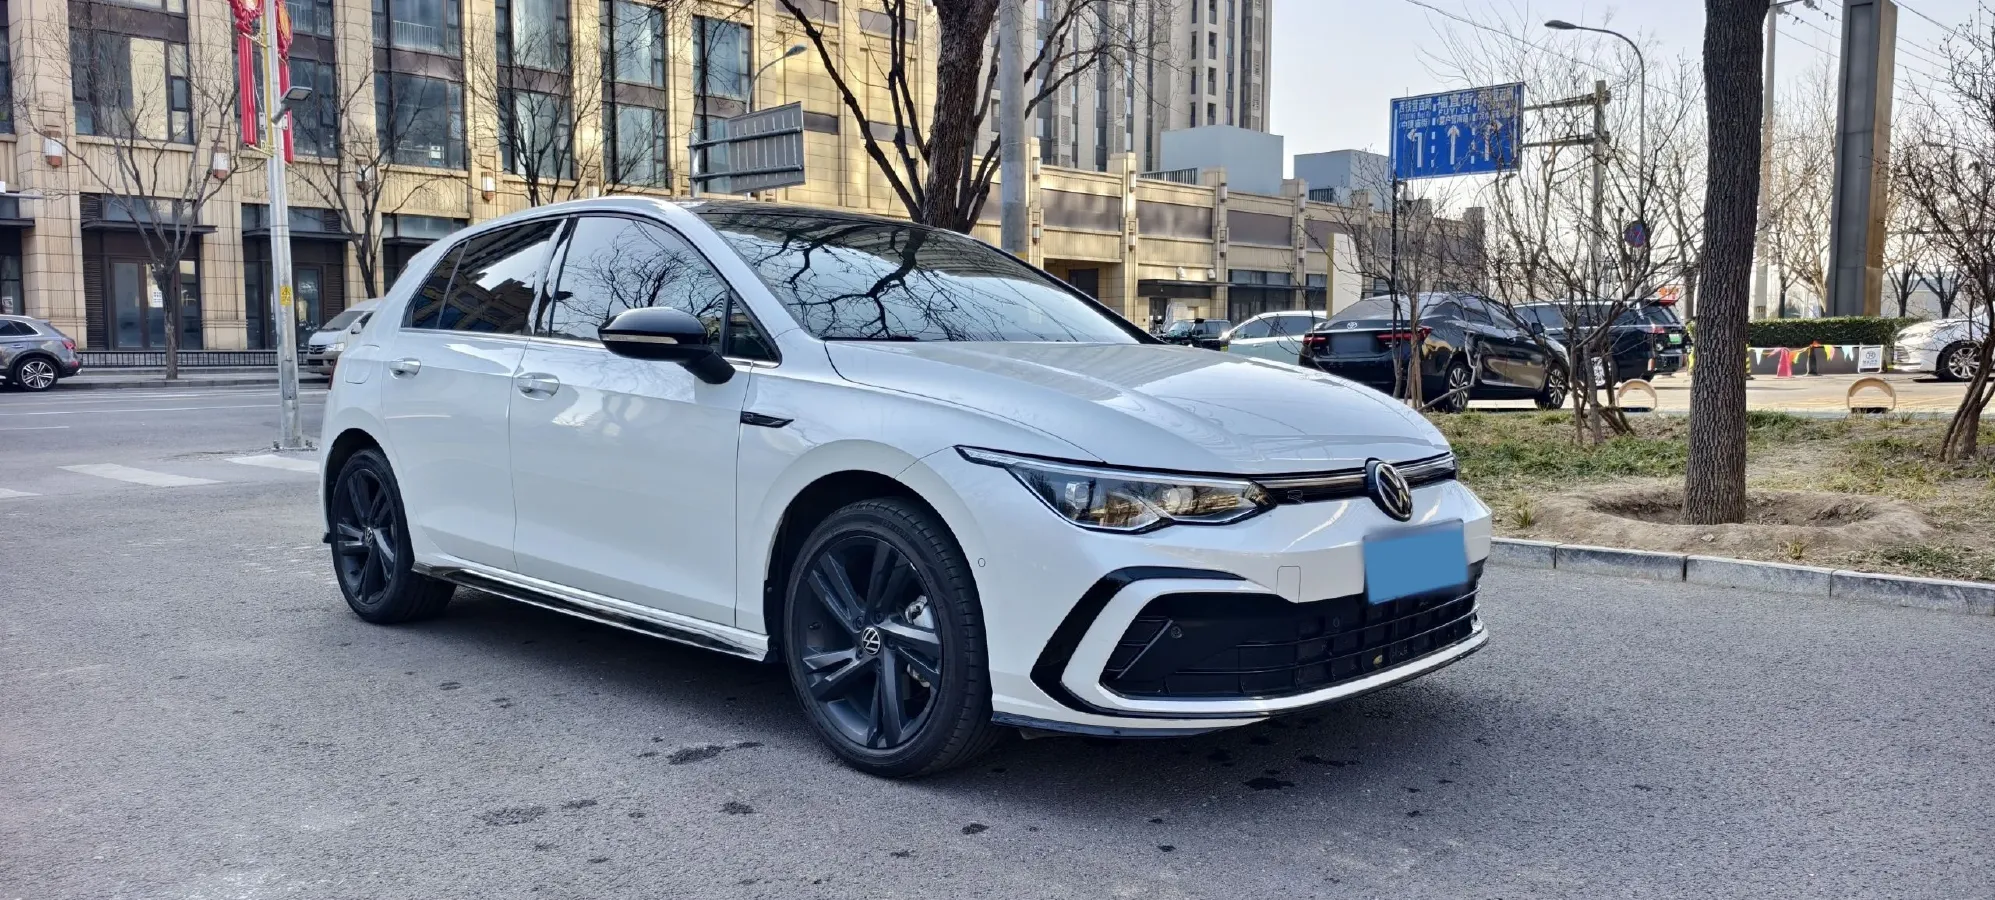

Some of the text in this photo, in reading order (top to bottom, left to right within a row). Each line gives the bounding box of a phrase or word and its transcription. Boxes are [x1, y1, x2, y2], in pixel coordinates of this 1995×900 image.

[1437, 93, 1473, 109] 福宜街
[1438, 107, 1458, 115] FUYI
